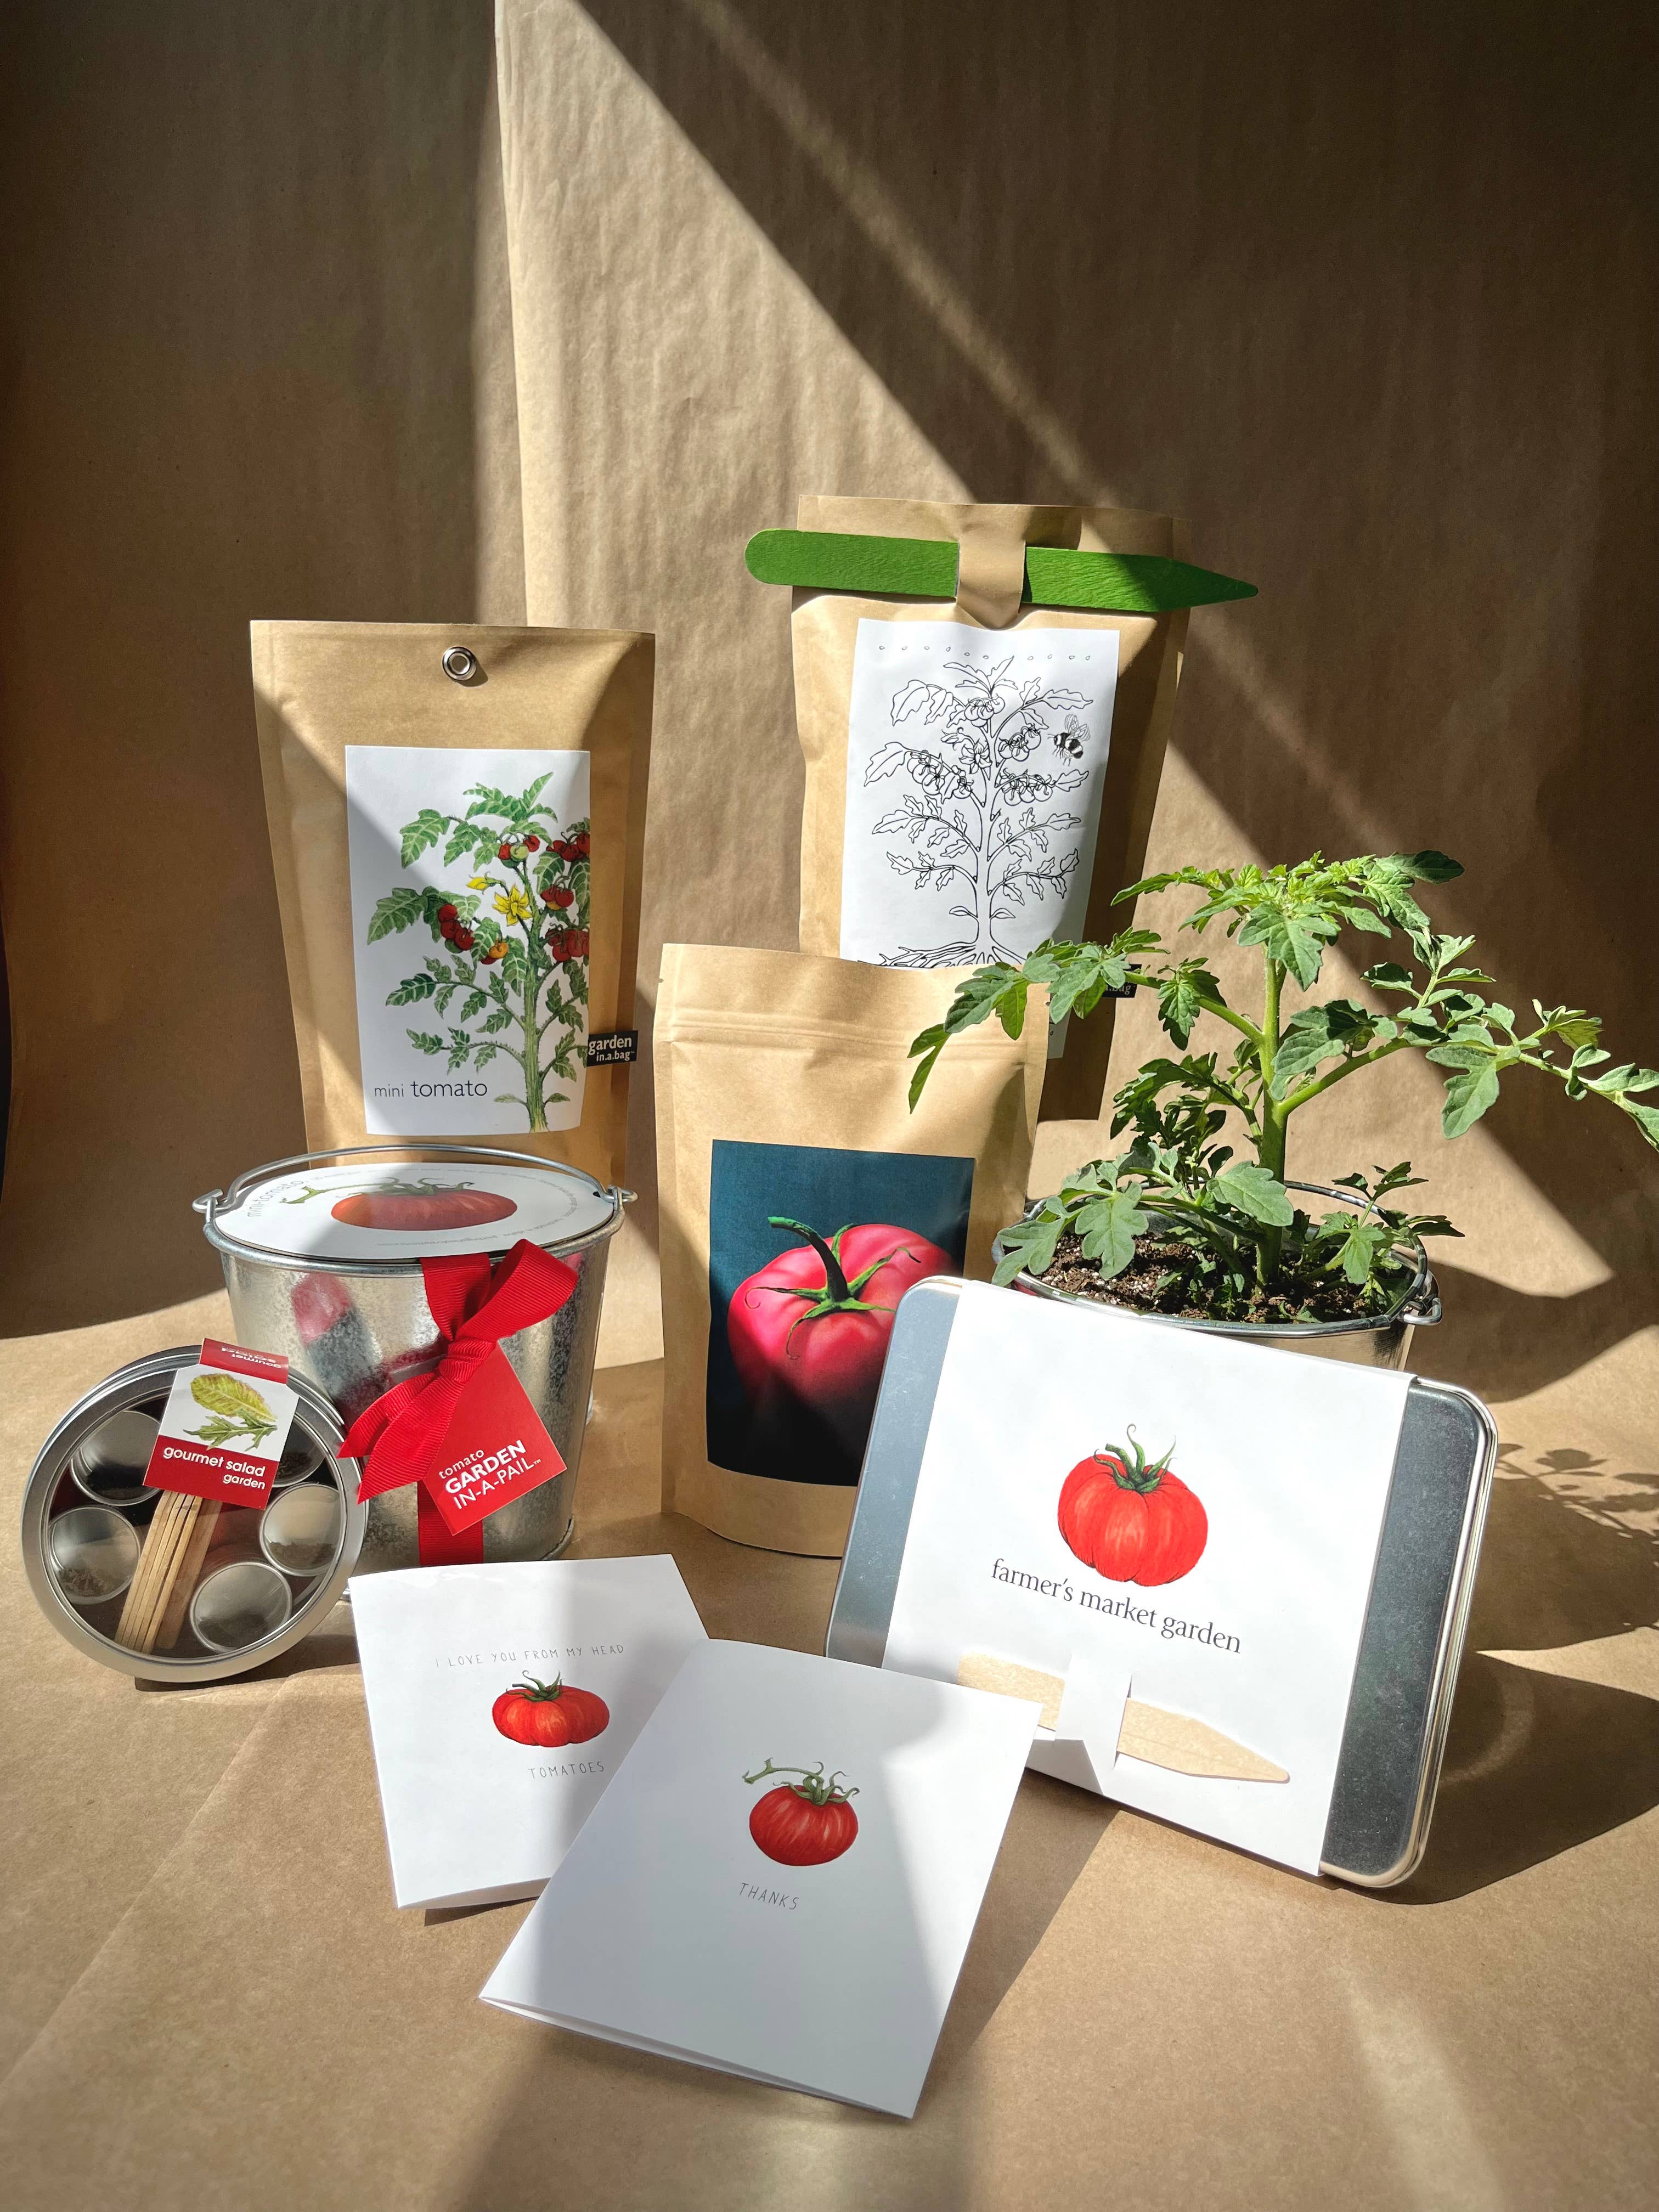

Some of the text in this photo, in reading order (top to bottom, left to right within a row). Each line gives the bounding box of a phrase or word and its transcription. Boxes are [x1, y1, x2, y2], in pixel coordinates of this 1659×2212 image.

[588, 1034, 632, 1056] garden
[374, 1080, 488, 1098] mini tomato
[163, 1446, 266, 1477] gourmet salad
[439, 1449, 484, 1480] tomato
[445, 1439, 527, 1494] GARDEN
[223, 1473, 266, 1490] garden
[991, 1558, 1241, 1654] farmer's market garden
[448, 1654, 483, 1667] LOVE
[491, 1651, 517, 1663] YOU
[524, 1649, 558, 1661] FROM
[566, 1646, 583, 1658] MY
[592, 1644, 625, 1656] HEAD
[528, 1760, 605, 1779] TOMATOES
[739, 1882, 799, 1910] THANKS
